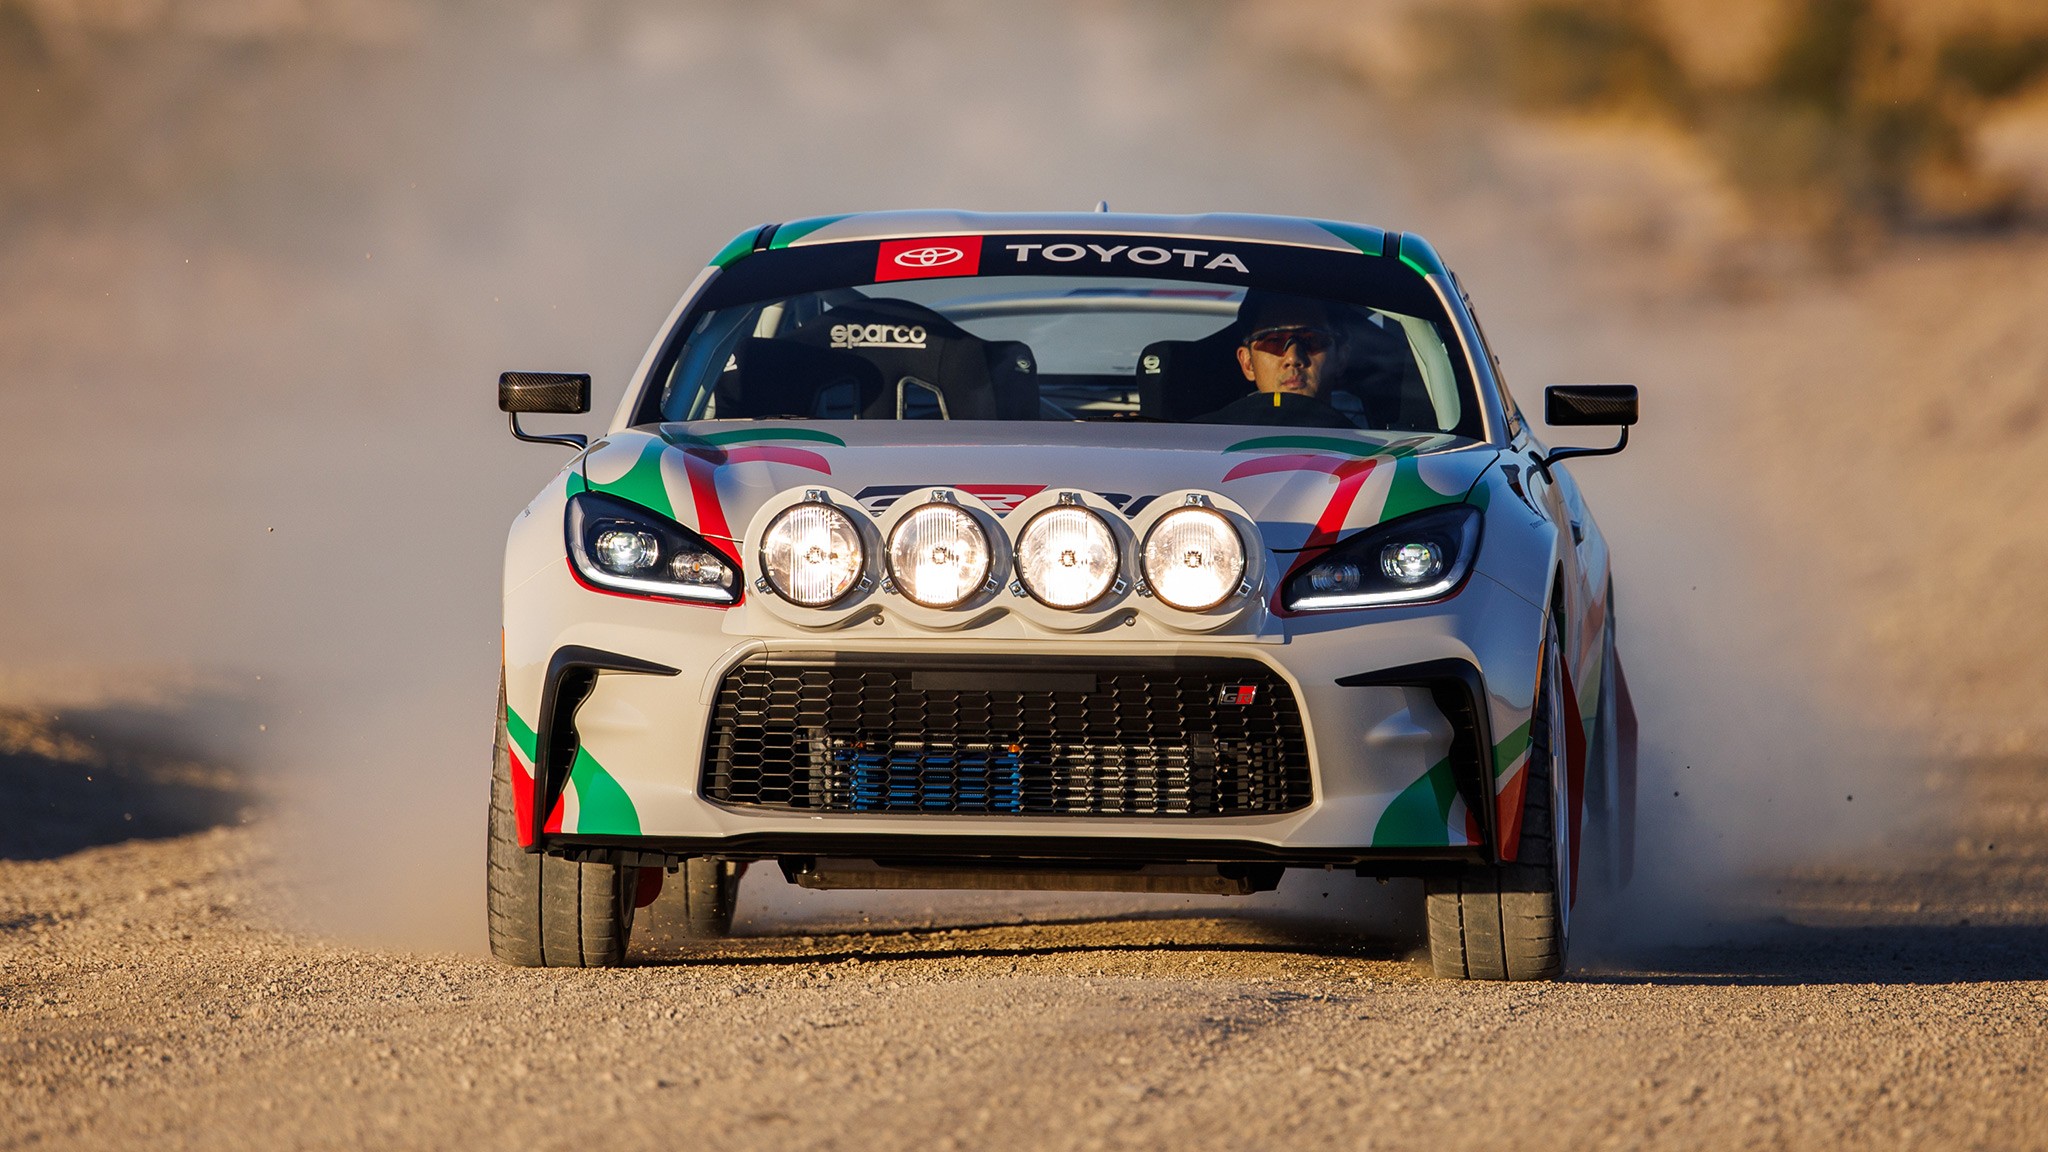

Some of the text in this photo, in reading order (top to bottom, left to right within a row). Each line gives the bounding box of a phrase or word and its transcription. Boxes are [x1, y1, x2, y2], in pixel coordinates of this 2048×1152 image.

[1006, 243, 1250, 273] TOYOTA
[830, 323, 927, 349] sparco
[1222, 692, 1252, 704] GR
